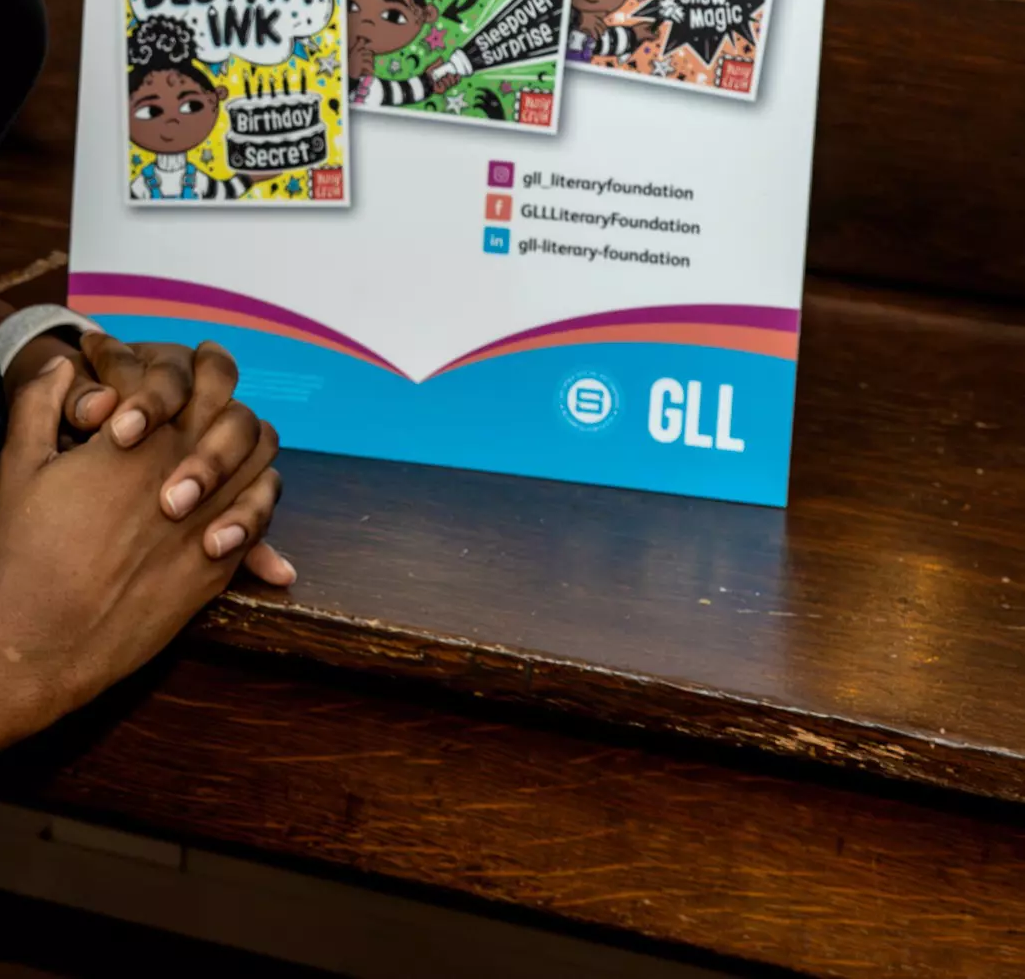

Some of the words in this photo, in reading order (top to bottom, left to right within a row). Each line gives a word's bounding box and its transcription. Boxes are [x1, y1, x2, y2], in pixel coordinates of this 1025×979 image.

[689, 1, 743, 32] Magic
[481, 22, 554, 66] Surprise
[236, 104, 314, 134] Birthday
[244, 141, 311, 168] Secret
[522, 171, 695, 201] gll_literaryfoundation
[520, 203, 701, 236] GLLLiteraryFoundation
[518, 237, 691, 268] gll-literary-foundation
[647, 376, 746, 453] GLL
